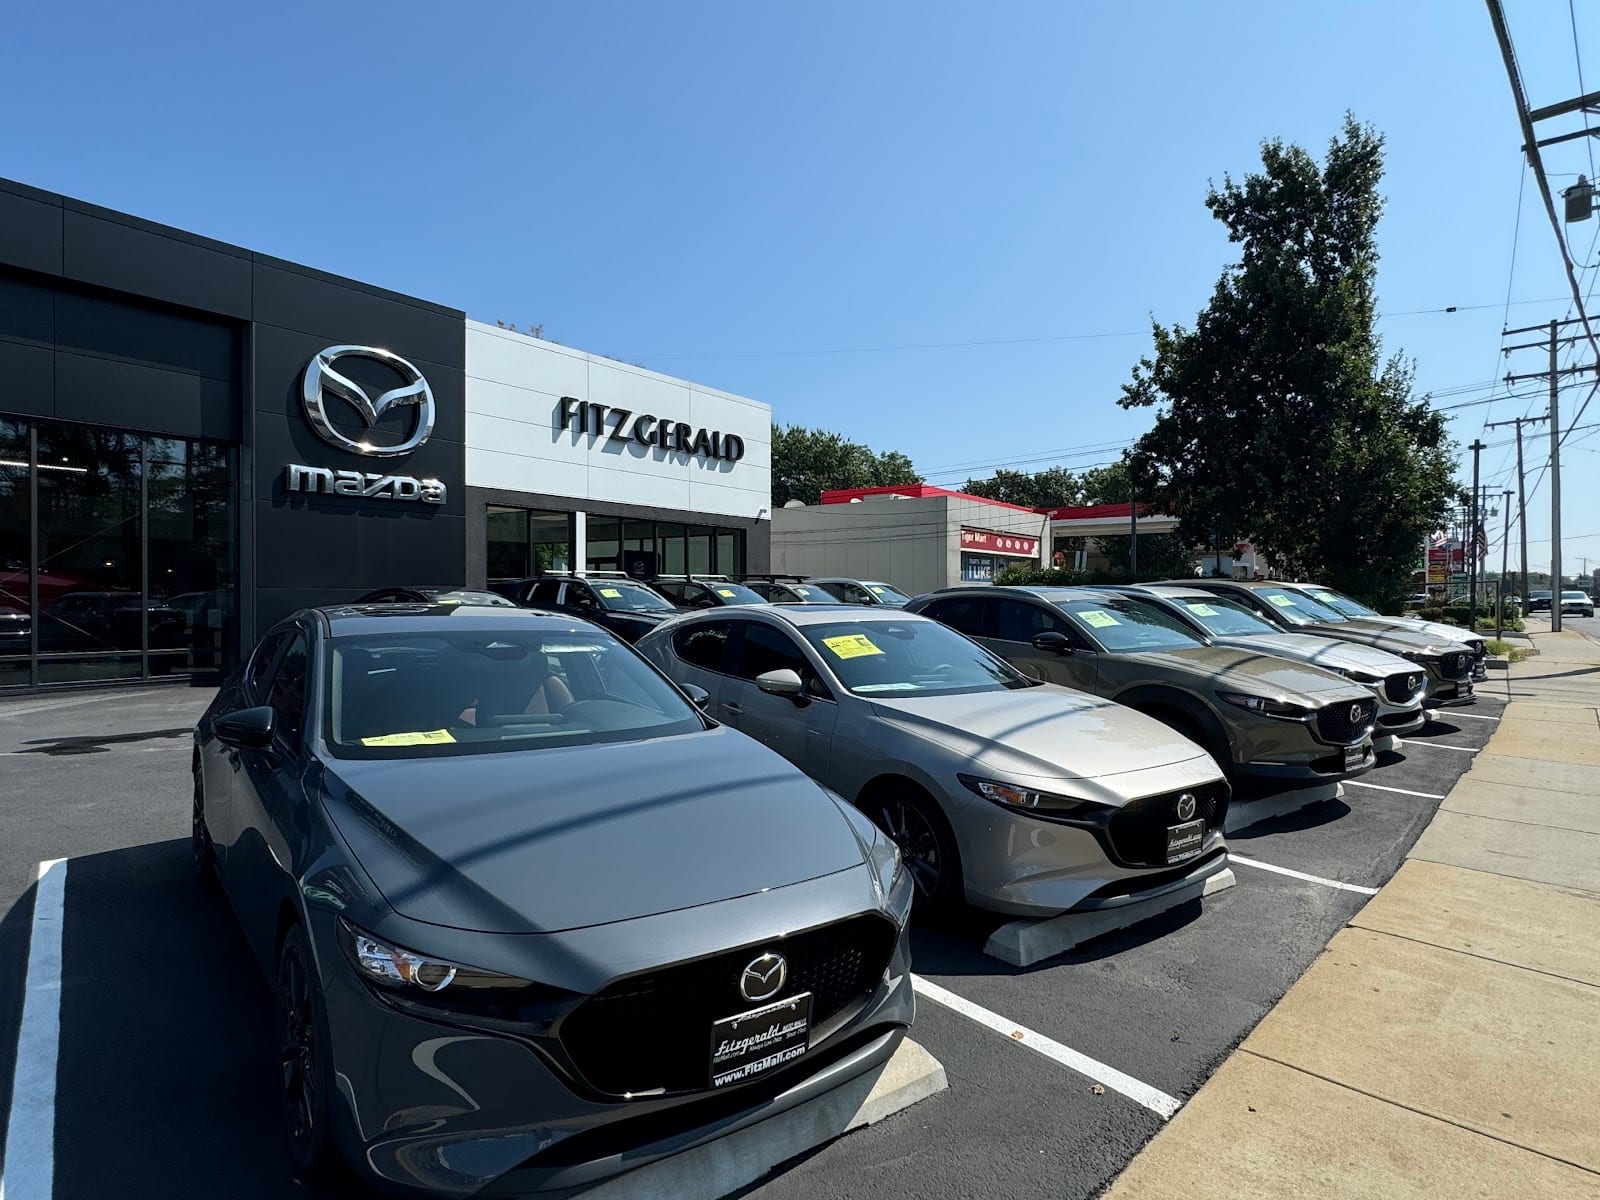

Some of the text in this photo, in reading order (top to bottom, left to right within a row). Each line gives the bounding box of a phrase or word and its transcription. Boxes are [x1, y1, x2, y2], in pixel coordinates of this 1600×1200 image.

[560, 396, 745, 463] FITZGERALD
[961, 531, 987, 544] Tiger Mart
[973, 566, 992, 579] LIKE
[714, 1023, 781, 1056] Fitzgerald
[714, 1046, 806, 1087] www.FitzMall.com
